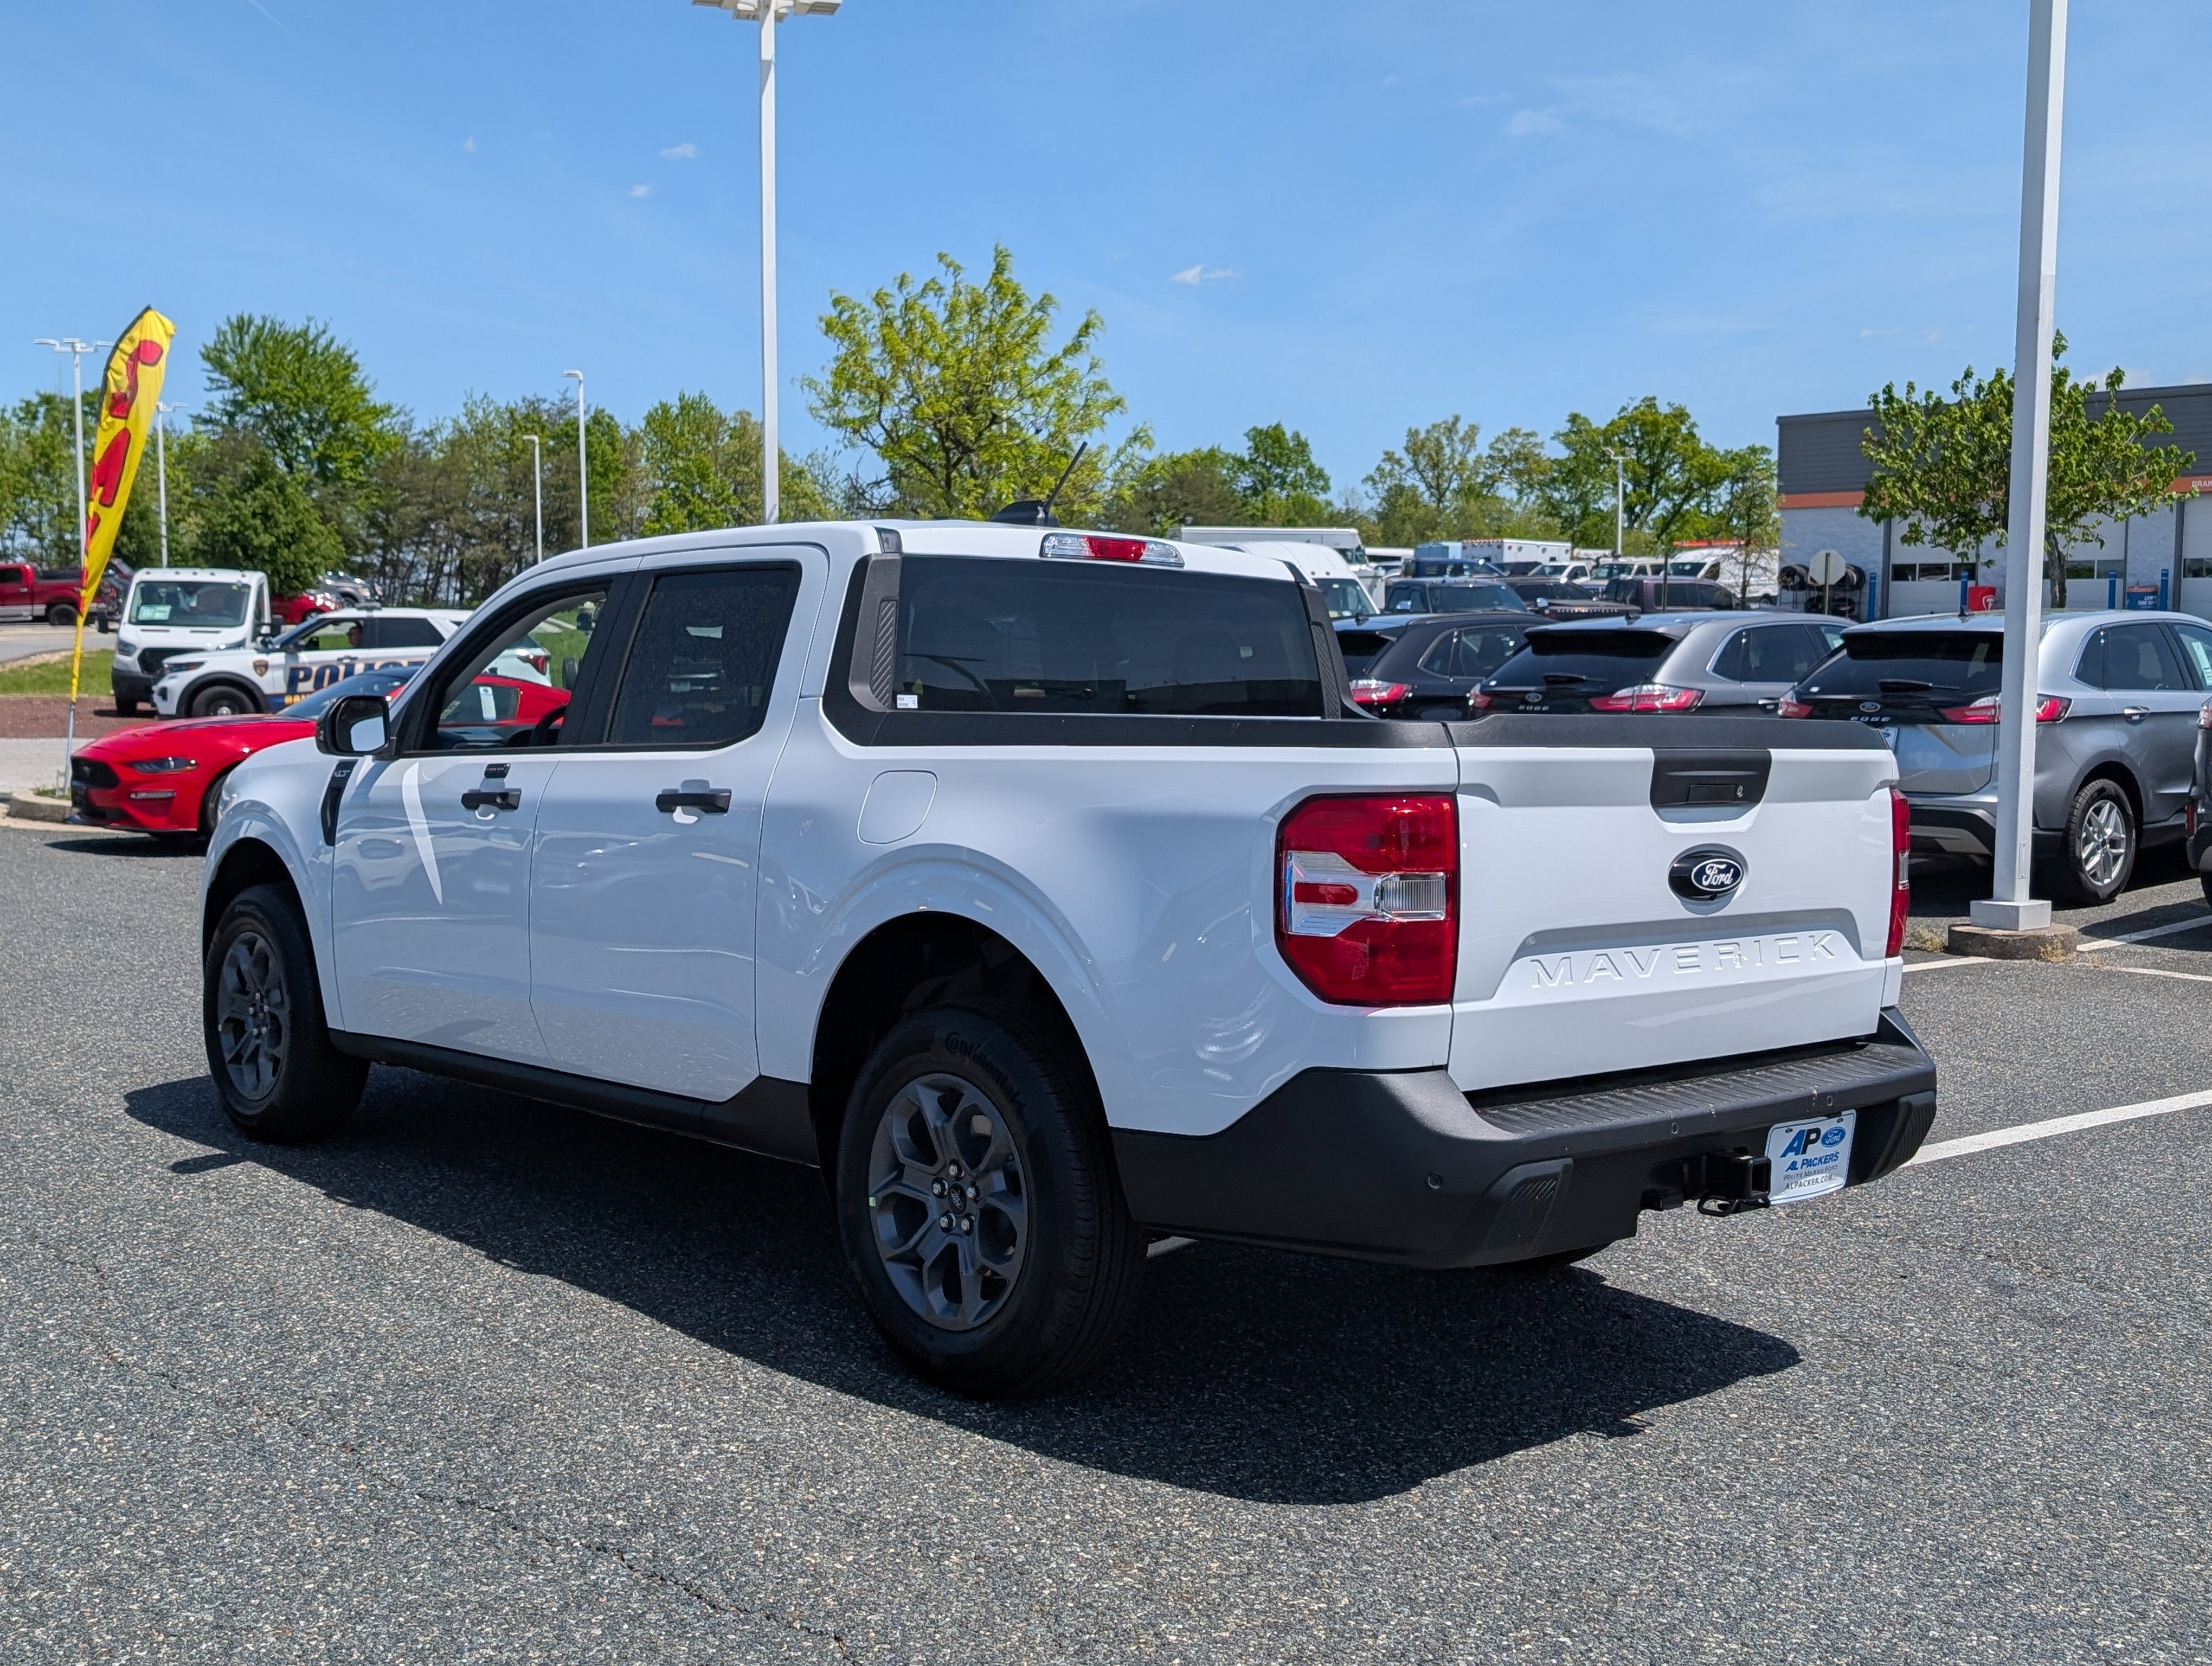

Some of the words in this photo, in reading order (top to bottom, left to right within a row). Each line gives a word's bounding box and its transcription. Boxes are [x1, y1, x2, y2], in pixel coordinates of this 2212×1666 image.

[1702, 863, 1734, 886] Ford
[1529, 933, 1836, 989] MAVERICK
[1779, 1127, 1821, 1158] AP
[1825, 1130, 1842, 1144] Ford
[1785, 1160, 1798, 1172] AL
